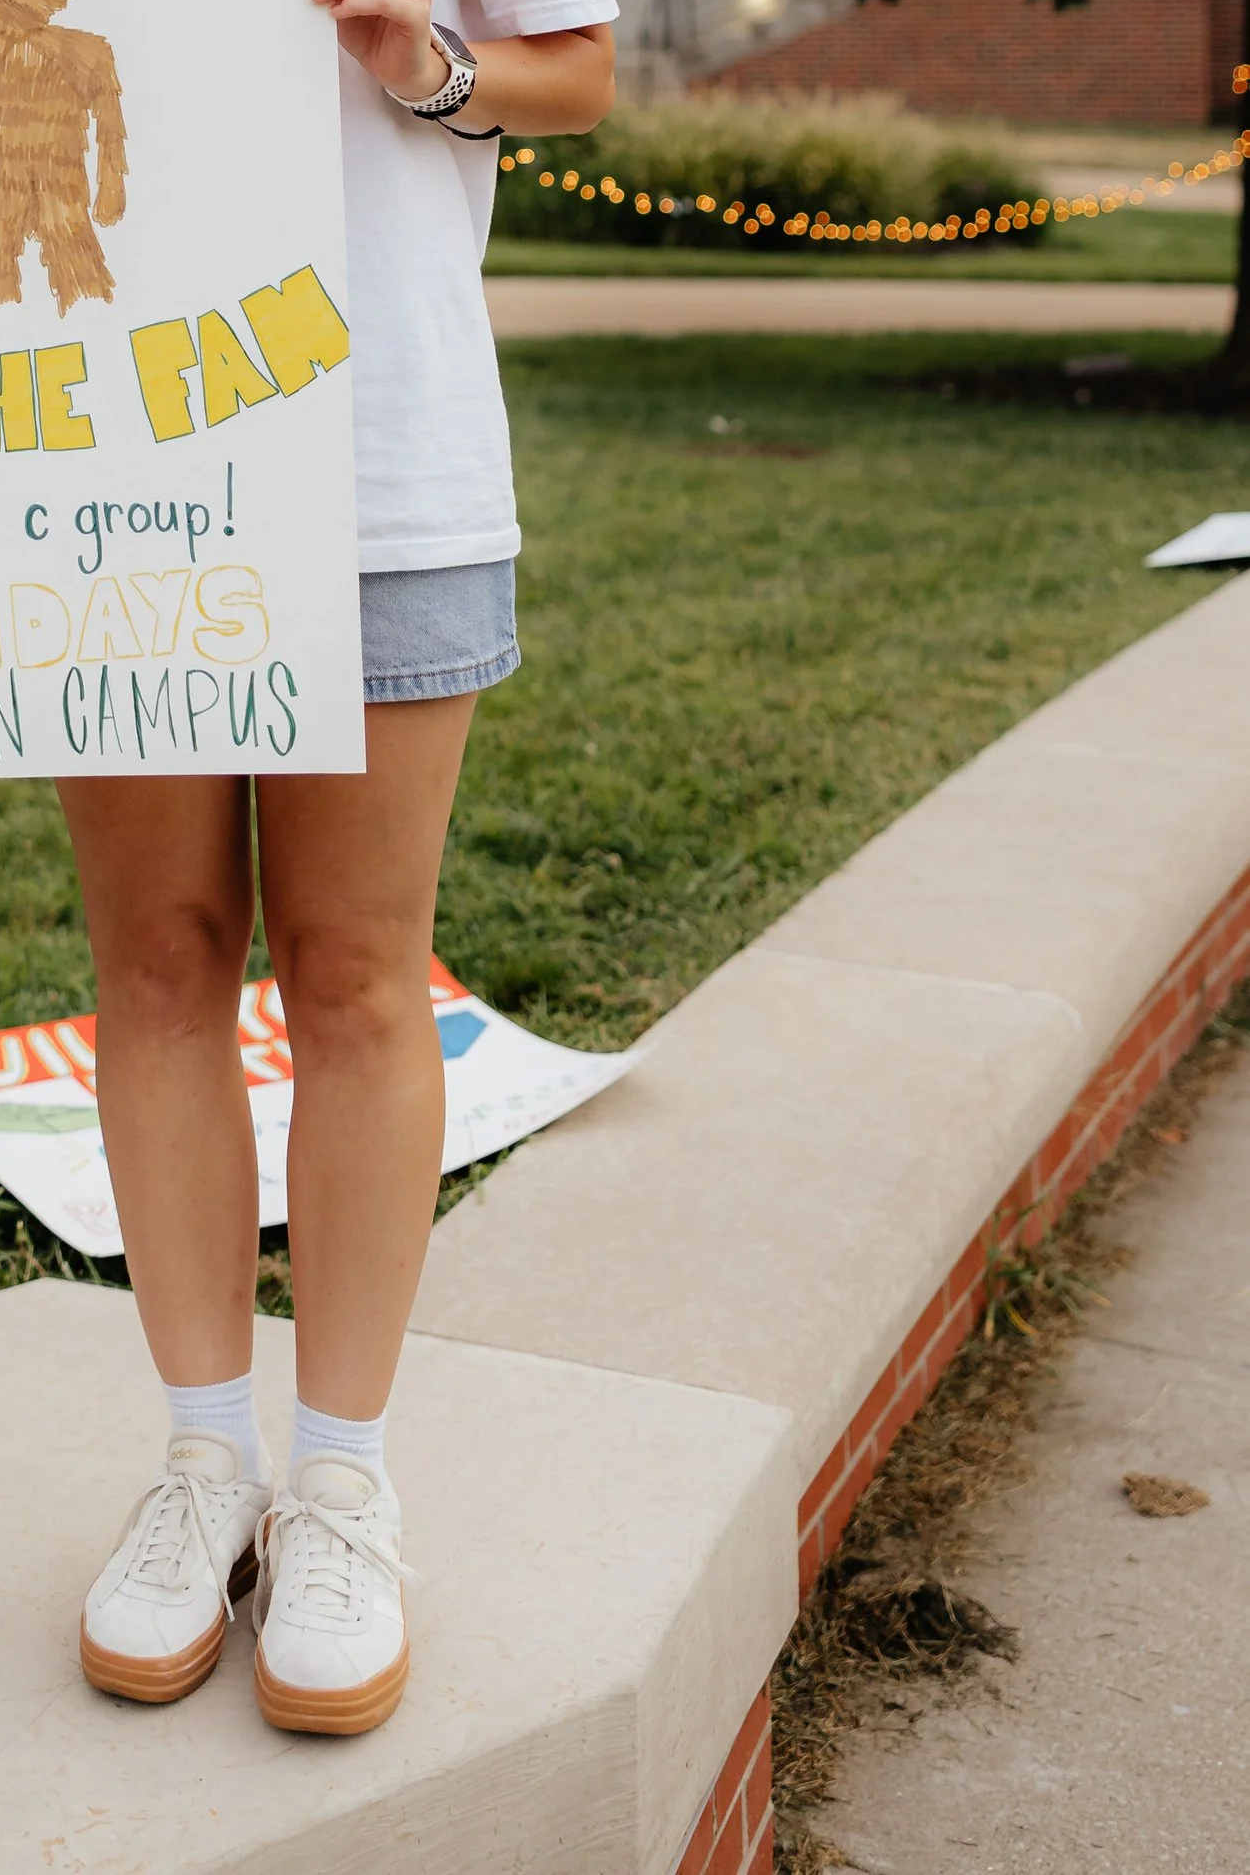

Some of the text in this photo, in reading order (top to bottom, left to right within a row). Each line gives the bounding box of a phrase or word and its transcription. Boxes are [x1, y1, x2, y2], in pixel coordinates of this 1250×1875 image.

[129, 264, 350, 443] FAM
[75, 462, 236, 574] group!
[62, 660, 299, 760] CAMPUS
